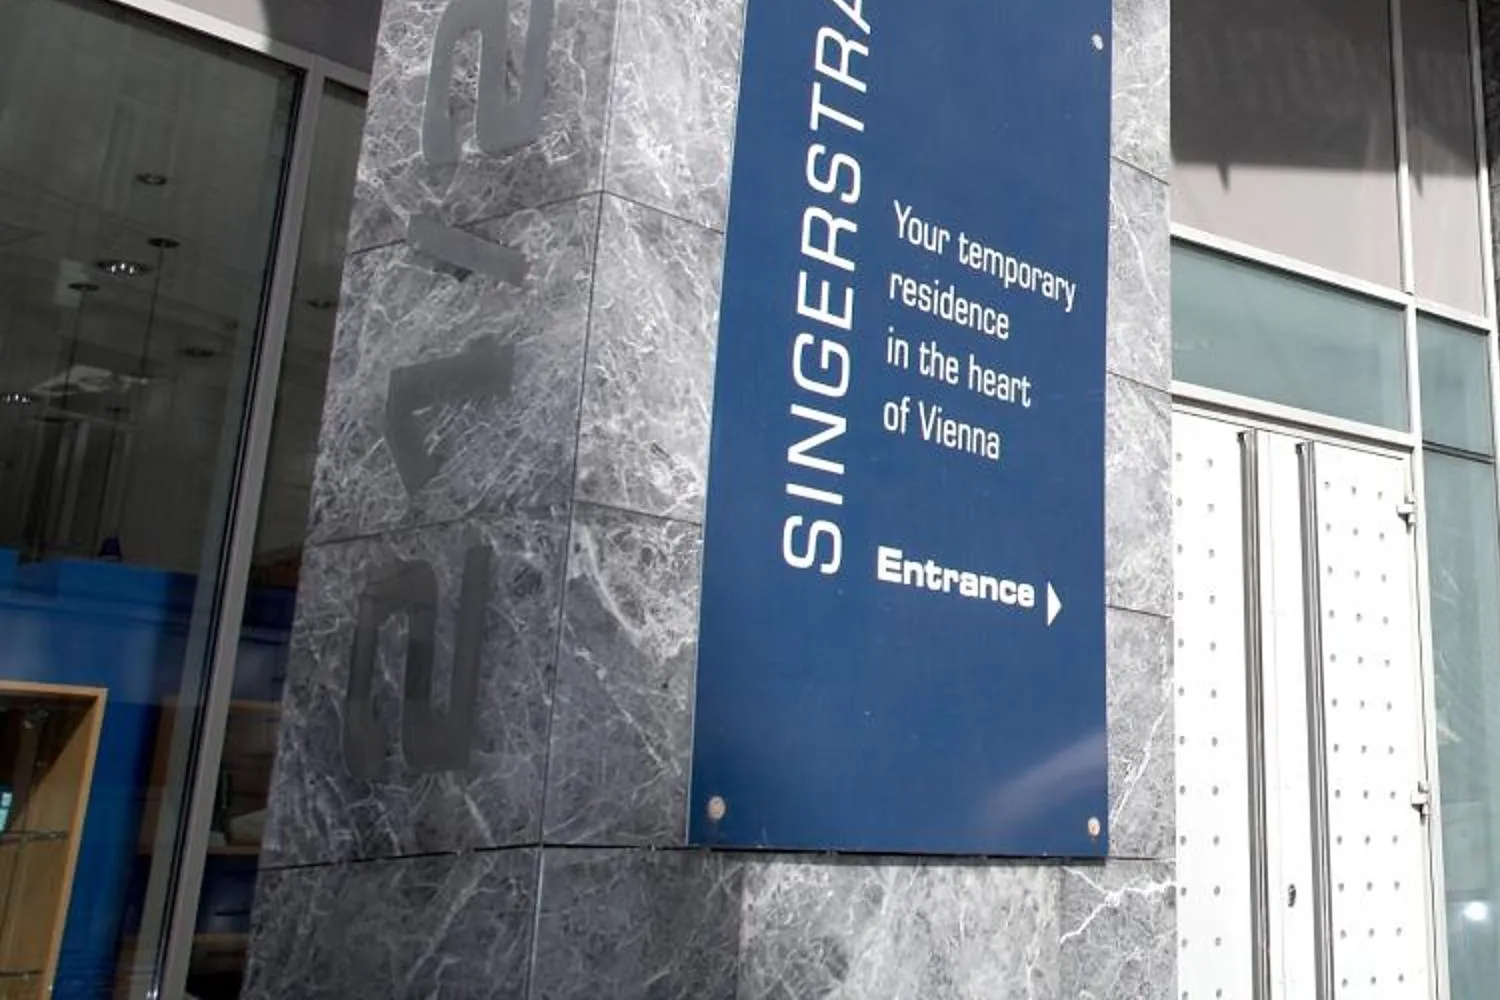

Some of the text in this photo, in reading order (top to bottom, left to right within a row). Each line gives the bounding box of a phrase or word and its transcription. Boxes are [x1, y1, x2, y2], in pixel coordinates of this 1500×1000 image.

[893, 199, 1077, 313] Your temporary
[889, 272, 1010, 340] residence
[887, 326, 1032, 408] in the heart
[883, 396, 1000, 460] of Vienna
[877, 546, 1035, 608] Entrance
